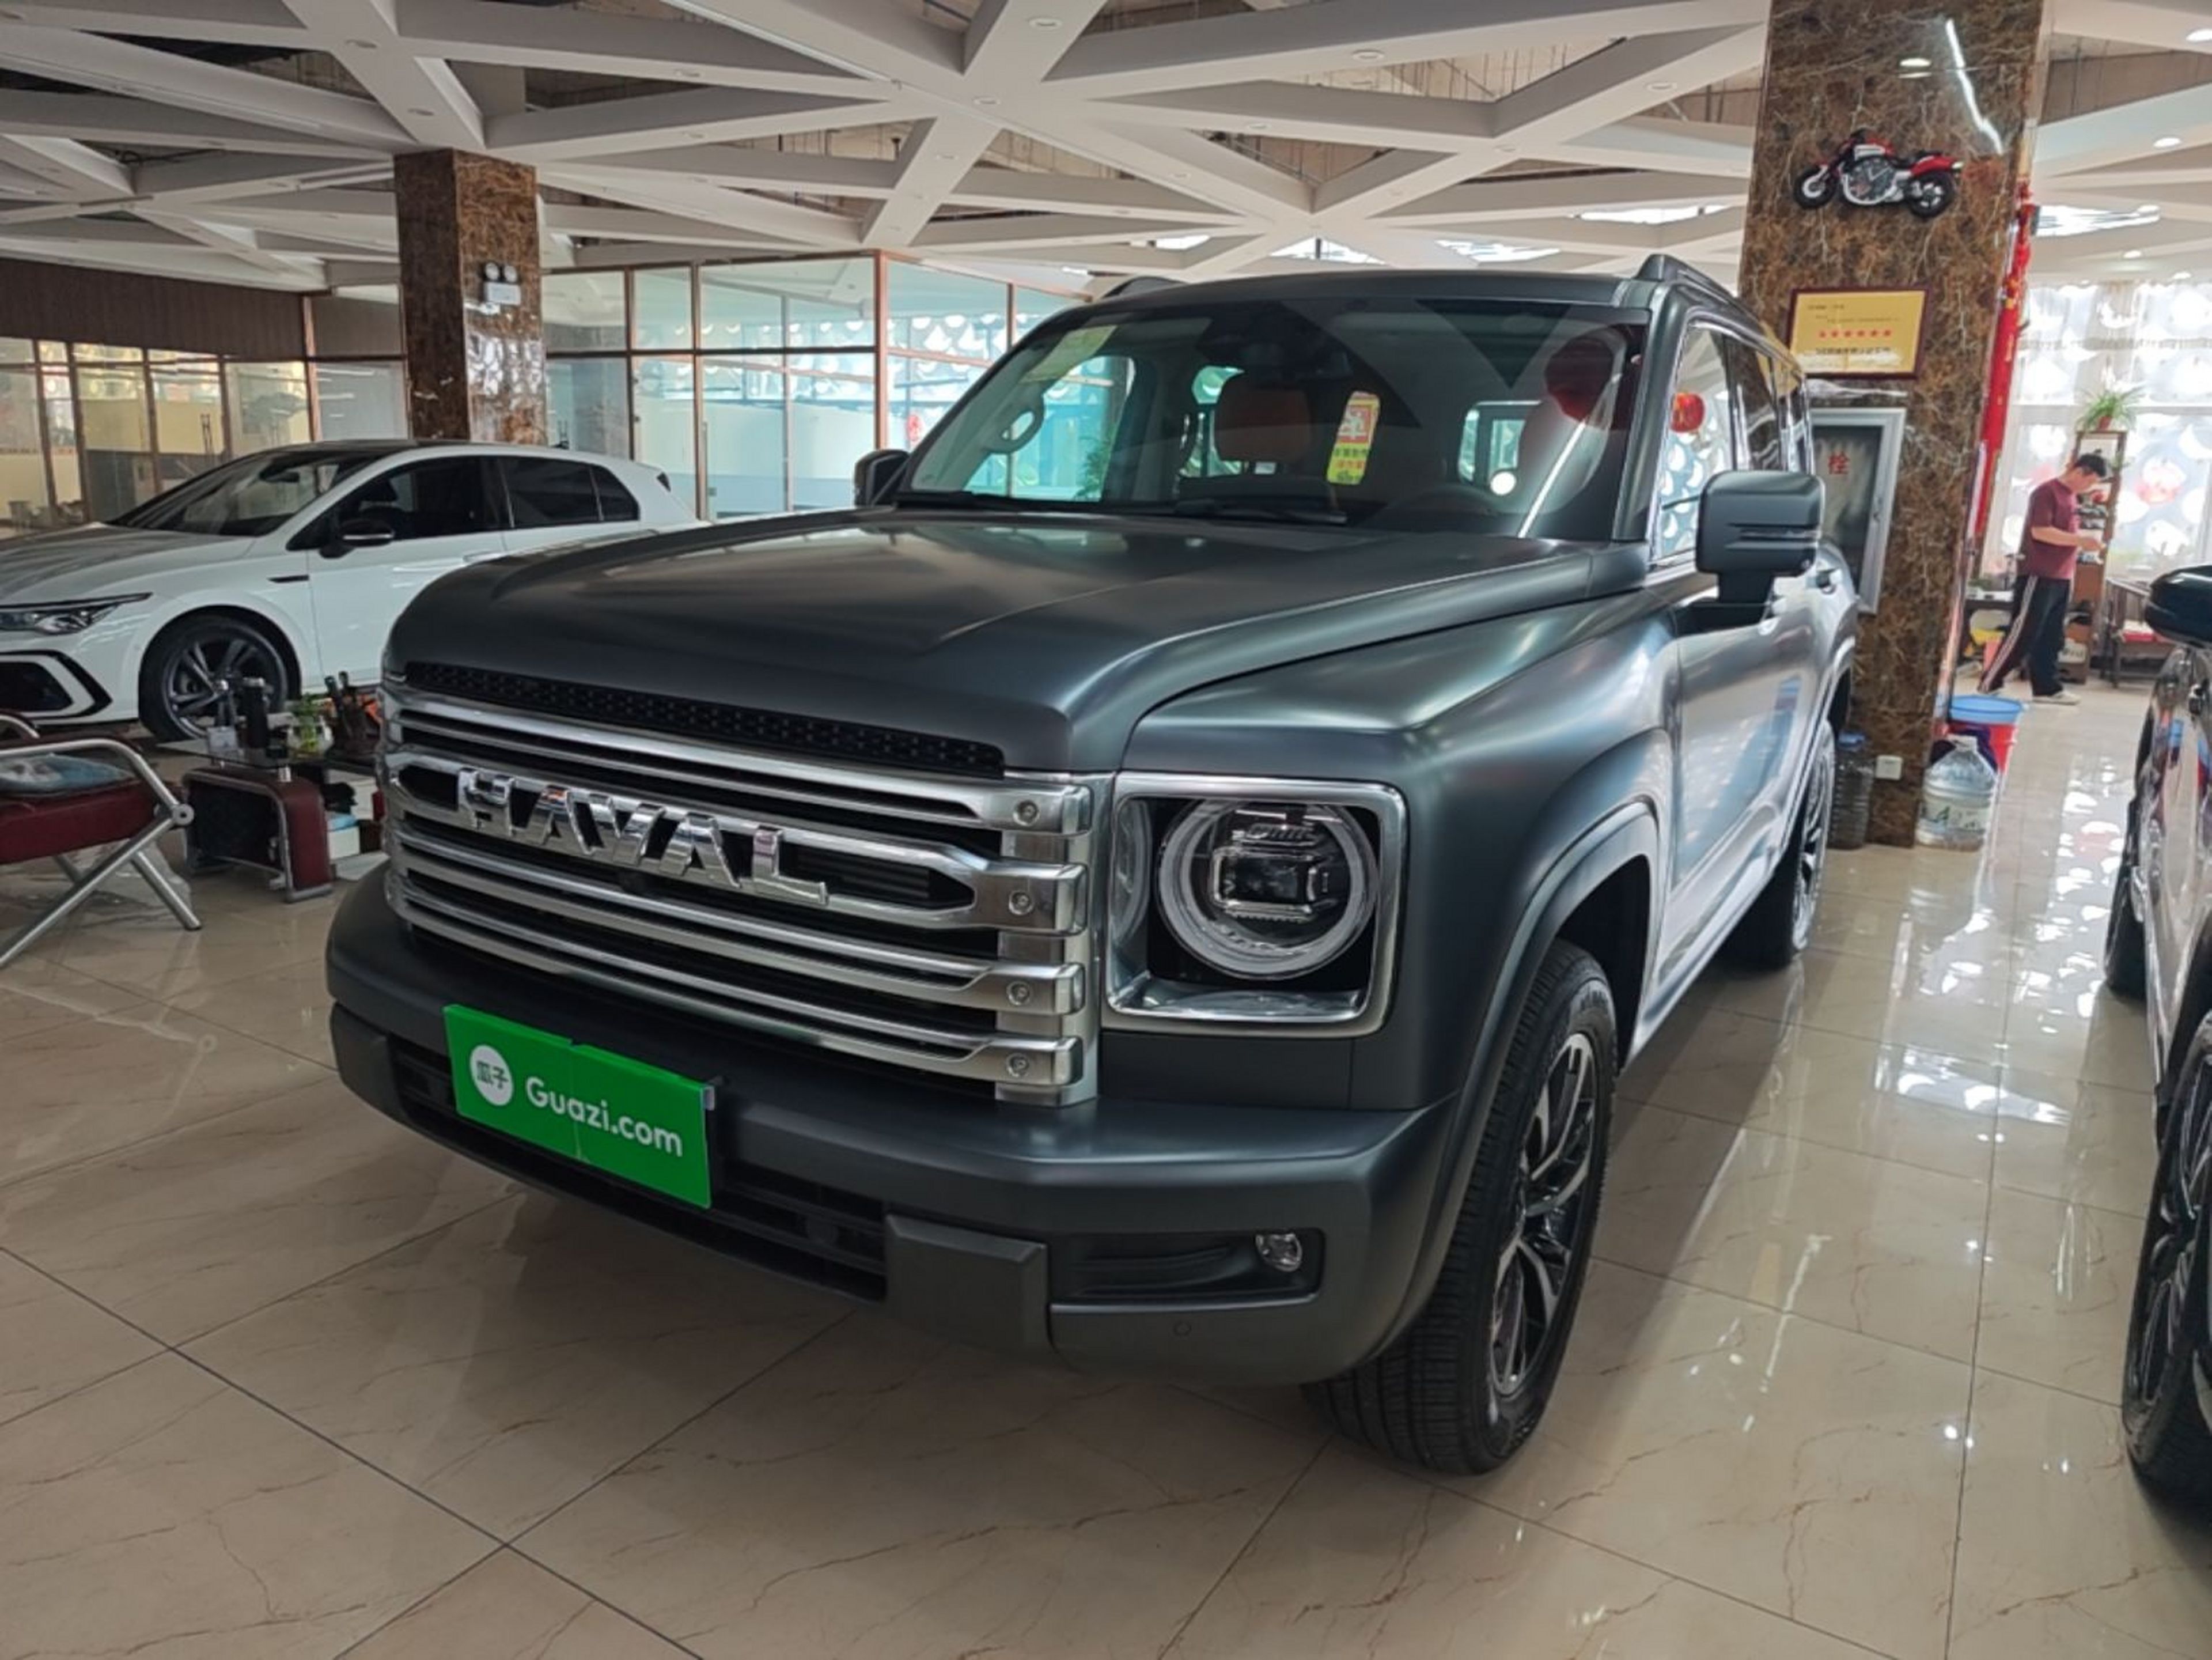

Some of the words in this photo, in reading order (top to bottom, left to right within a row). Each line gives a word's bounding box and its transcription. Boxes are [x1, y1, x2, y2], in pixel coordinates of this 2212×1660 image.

[1828, 451, 1850, 475] 栓
[458, 767, 830, 906] HAVAL
[476, 1060, 509, 1090] 瓜子
[525, 1076, 683, 1158] Guazi.com
